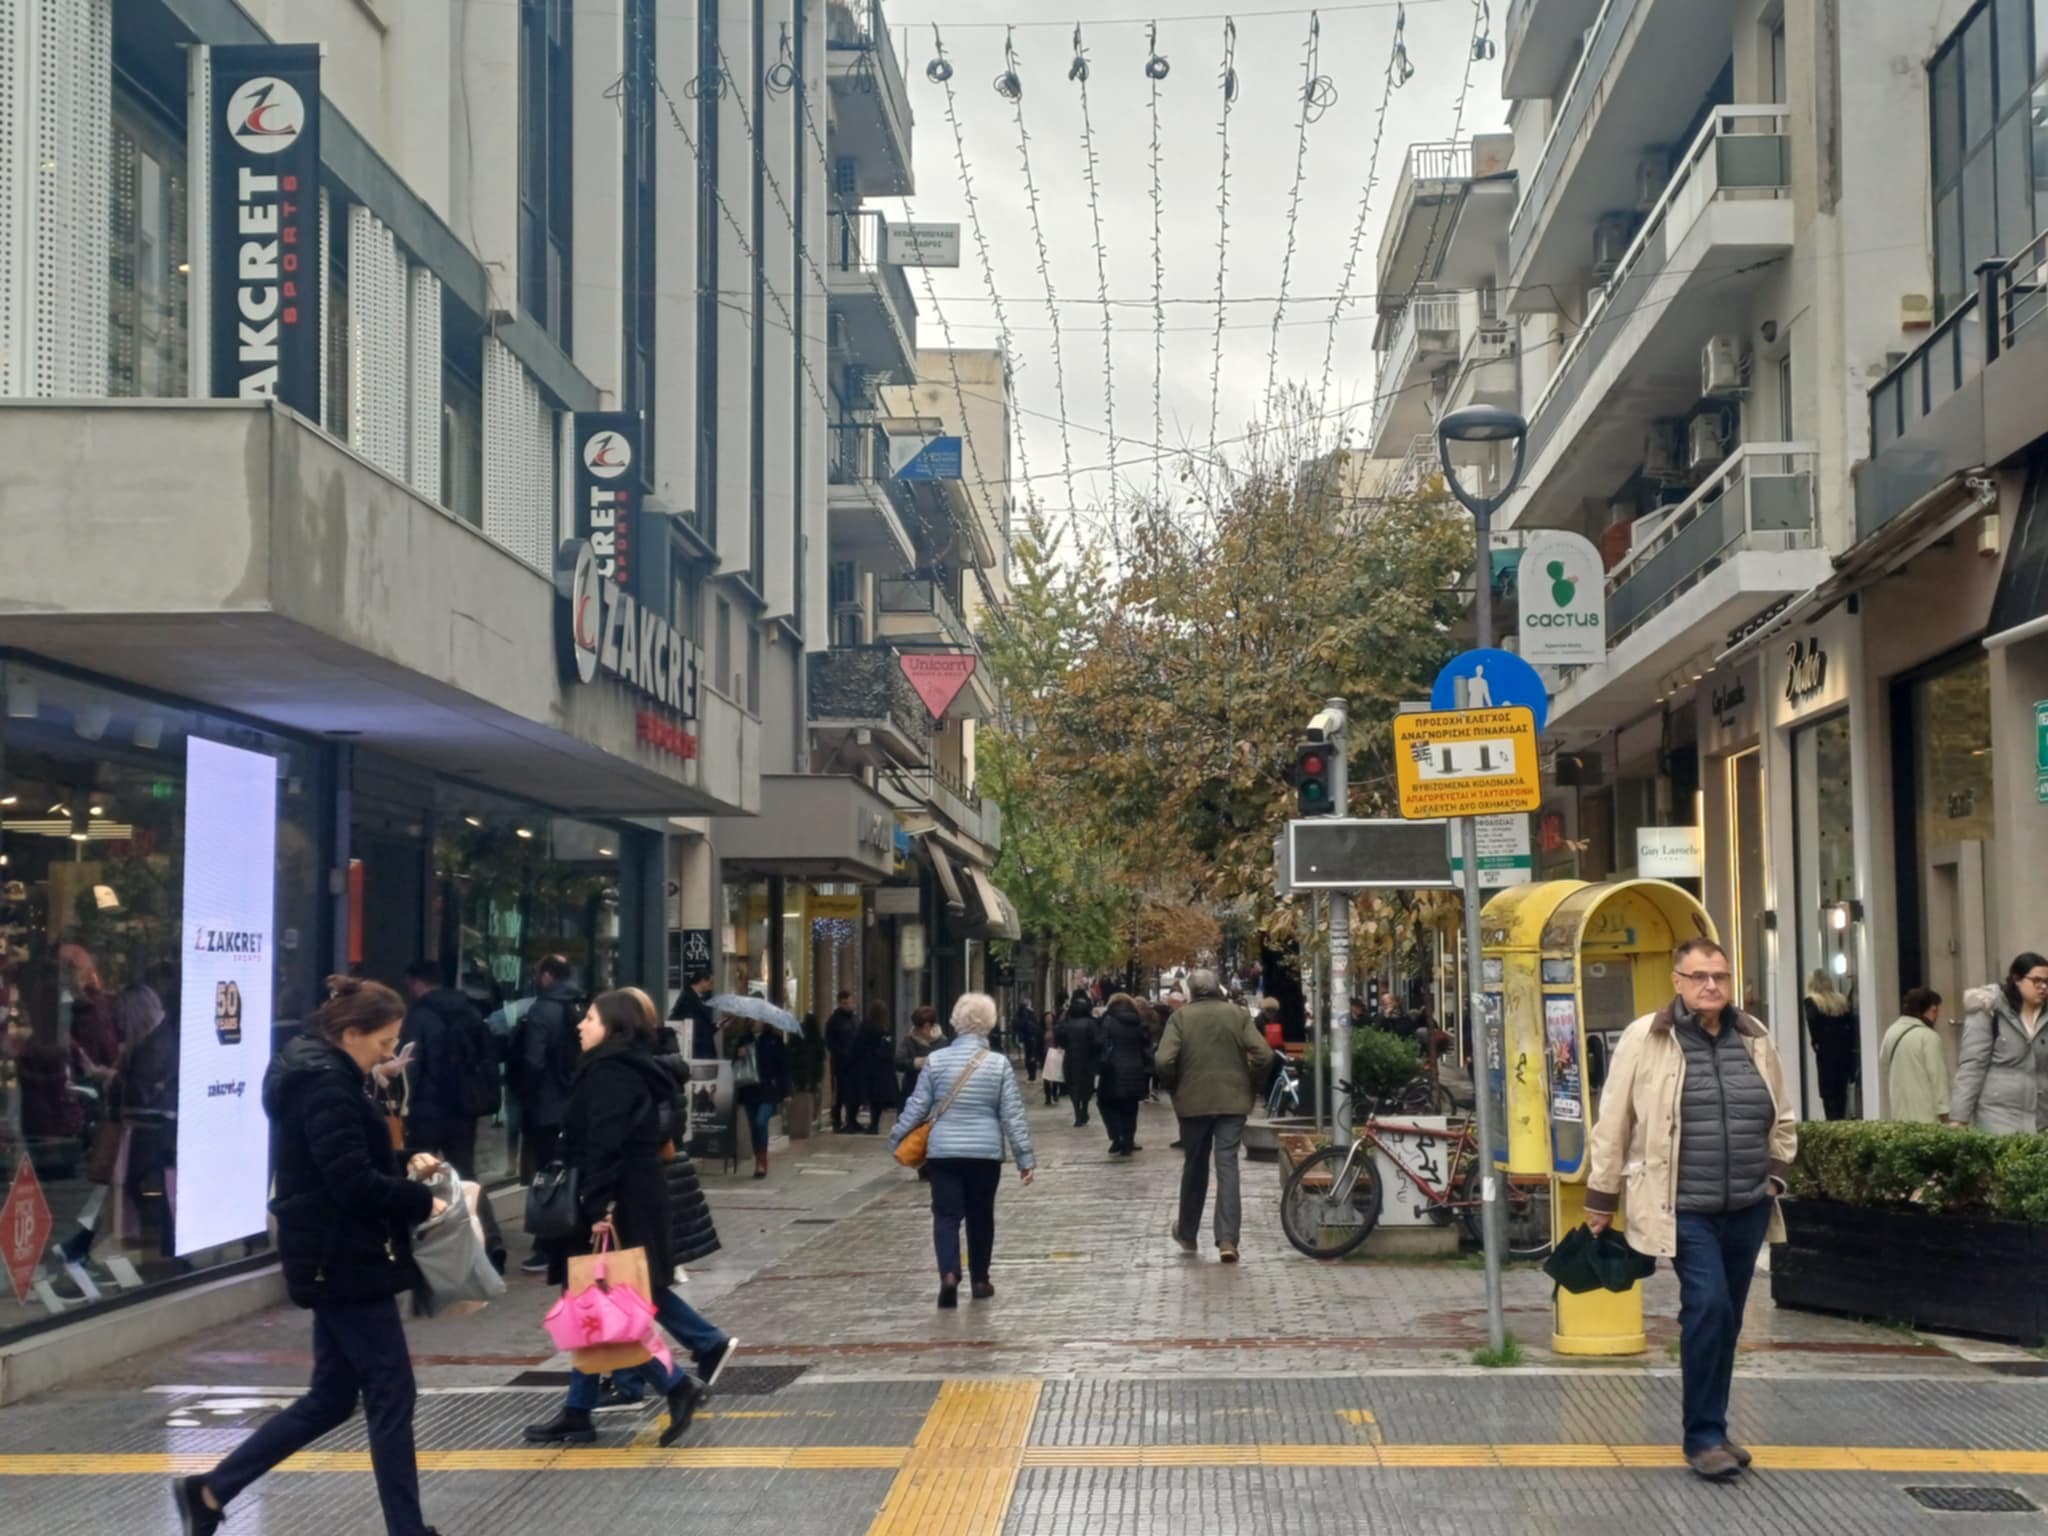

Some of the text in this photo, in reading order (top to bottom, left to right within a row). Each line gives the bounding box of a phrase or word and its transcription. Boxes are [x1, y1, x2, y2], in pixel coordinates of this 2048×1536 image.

[283, 176, 297, 324] SPORTS
[239, 167, 279, 401] AKCRET
[591, 486, 615, 578] CRET
[601, 578, 704, 720] ZAKCRET
[908, 658, 967, 671] Unicorn
[1415, 715, 1463, 727] ΠΡΟΣΟΧΗ
[1473, 724, 1528, 736] ΠΙΝΑΚΙΔΑΣ
[1406, 793, 1469, 803] ΑΠΑΓΟΡΕΥΕΤΑΙ
[1479, 788, 1533, 799] ΤΑΥΤΟΧΡΟΝΗ
[1412, 781, 1470, 792] ΒΥΘΙΖΟΜΕΝΑ
[1414, 803, 1457, 814] ΔΙΕΛΕΥΣΗ
[1459, 802, 1476, 811] ΔΥΟ
[207, 930, 263, 953] ZAKCRET
[217, 982, 238, 1016] 50
[15, 1216, 34, 1248] UP
